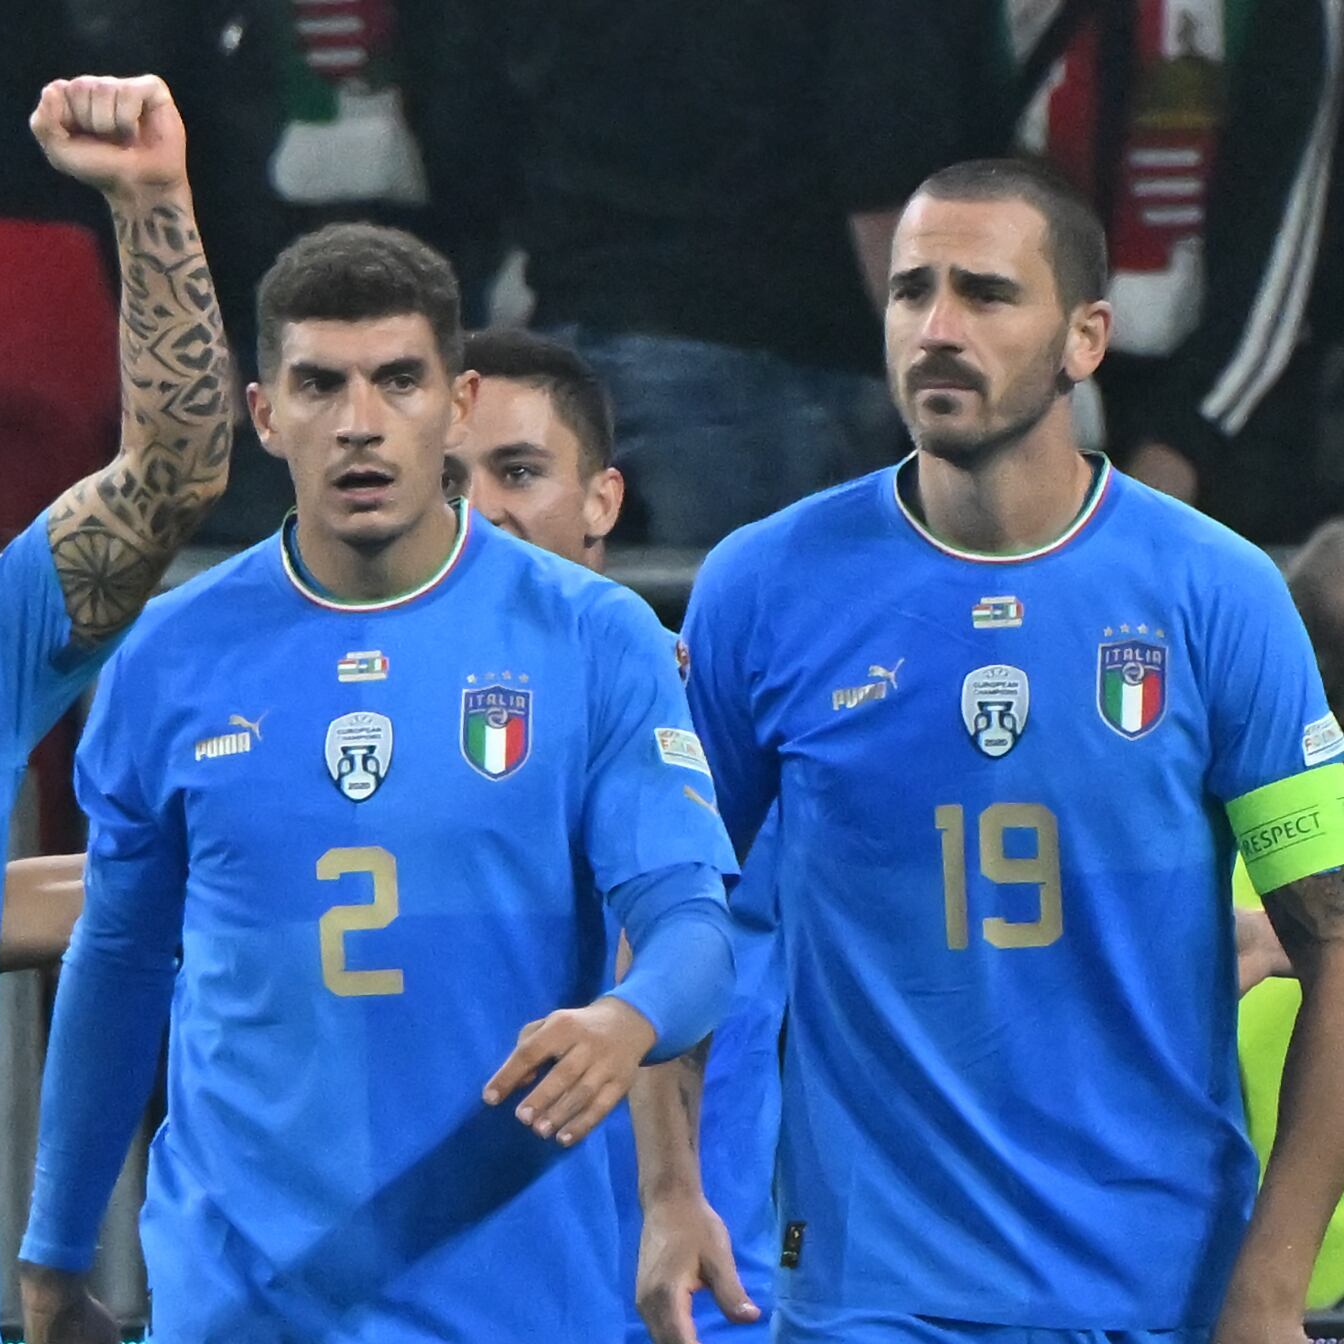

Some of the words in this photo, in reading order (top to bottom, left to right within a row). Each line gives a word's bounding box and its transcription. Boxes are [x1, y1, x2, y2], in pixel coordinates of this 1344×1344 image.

[1104, 647, 1162, 665] ITALIA
[468, 693, 526, 708] ITALIA
[194, 731, 251, 762] PUMA
[1240, 811, 1322, 857] RESPECT
[933, 801, 1064, 951] 19
[315, 846, 404, 997] 2
